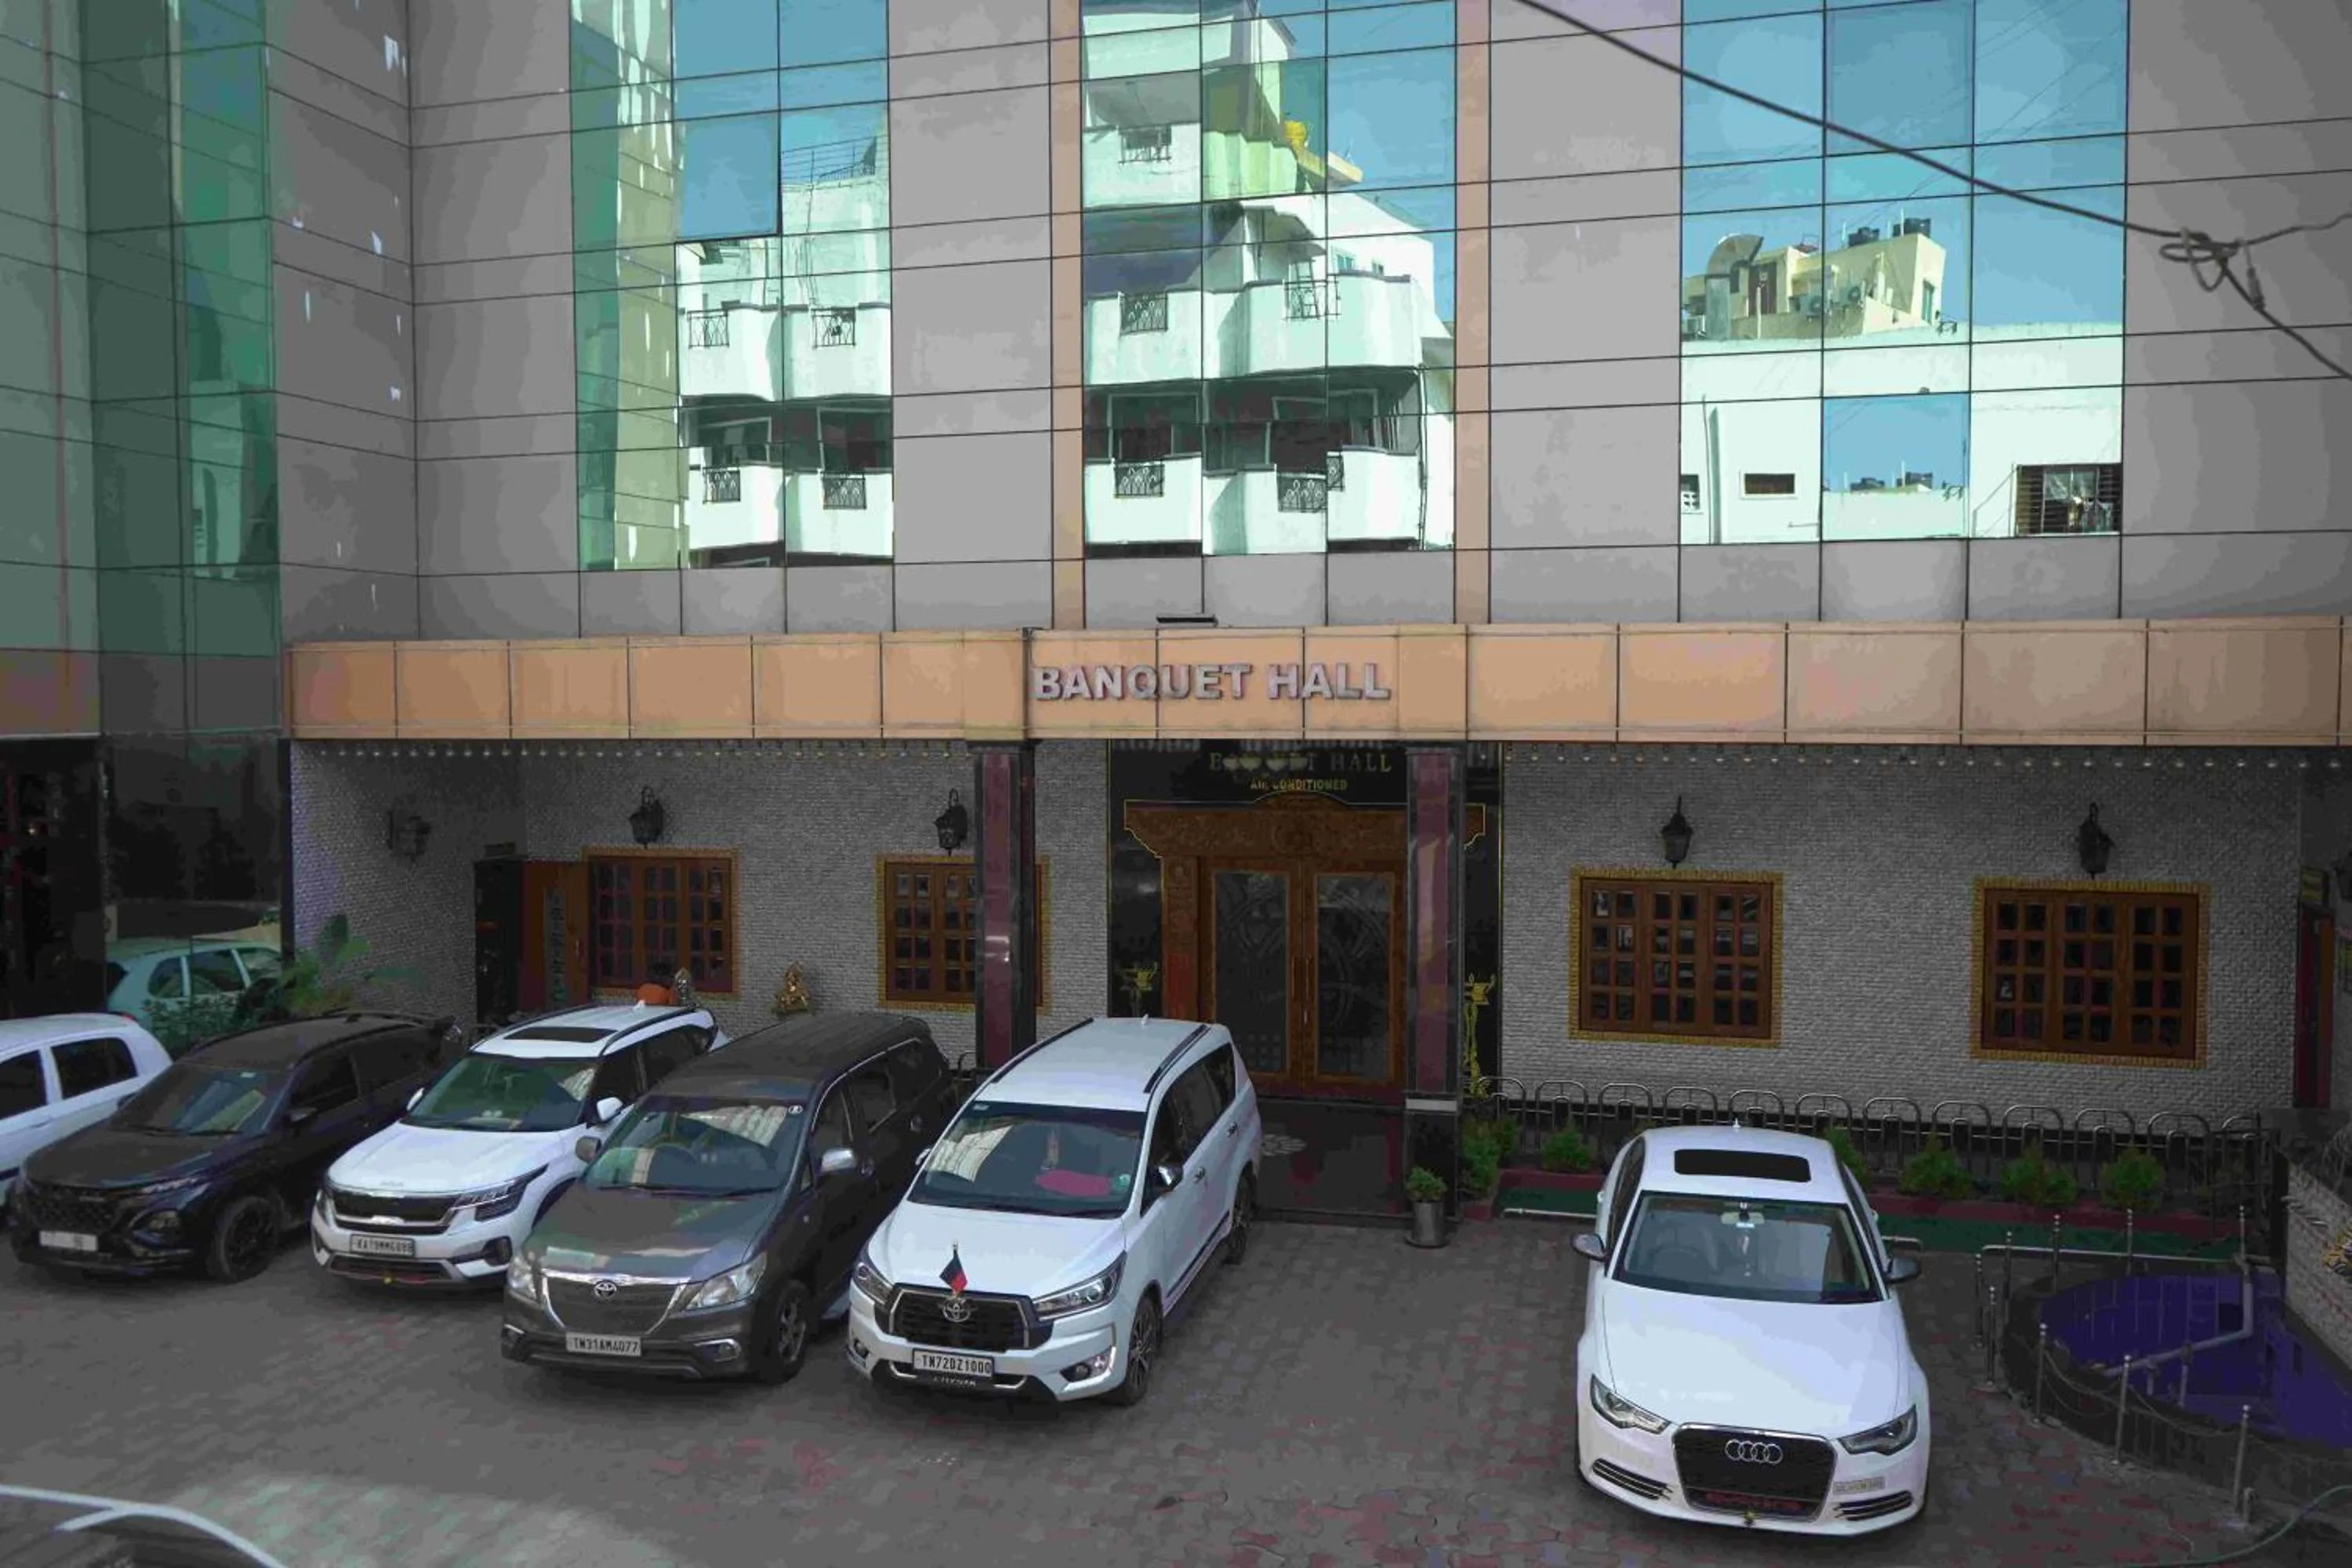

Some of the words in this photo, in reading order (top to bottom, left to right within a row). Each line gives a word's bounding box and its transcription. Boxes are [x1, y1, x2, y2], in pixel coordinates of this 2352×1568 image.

[1032, 664, 1254, 701] BANQUET
[1266, 662, 1391, 700] HALL
[1331, 752, 1392, 773] HALL
[921, 1353, 992, 1374] TN72DZ1000
